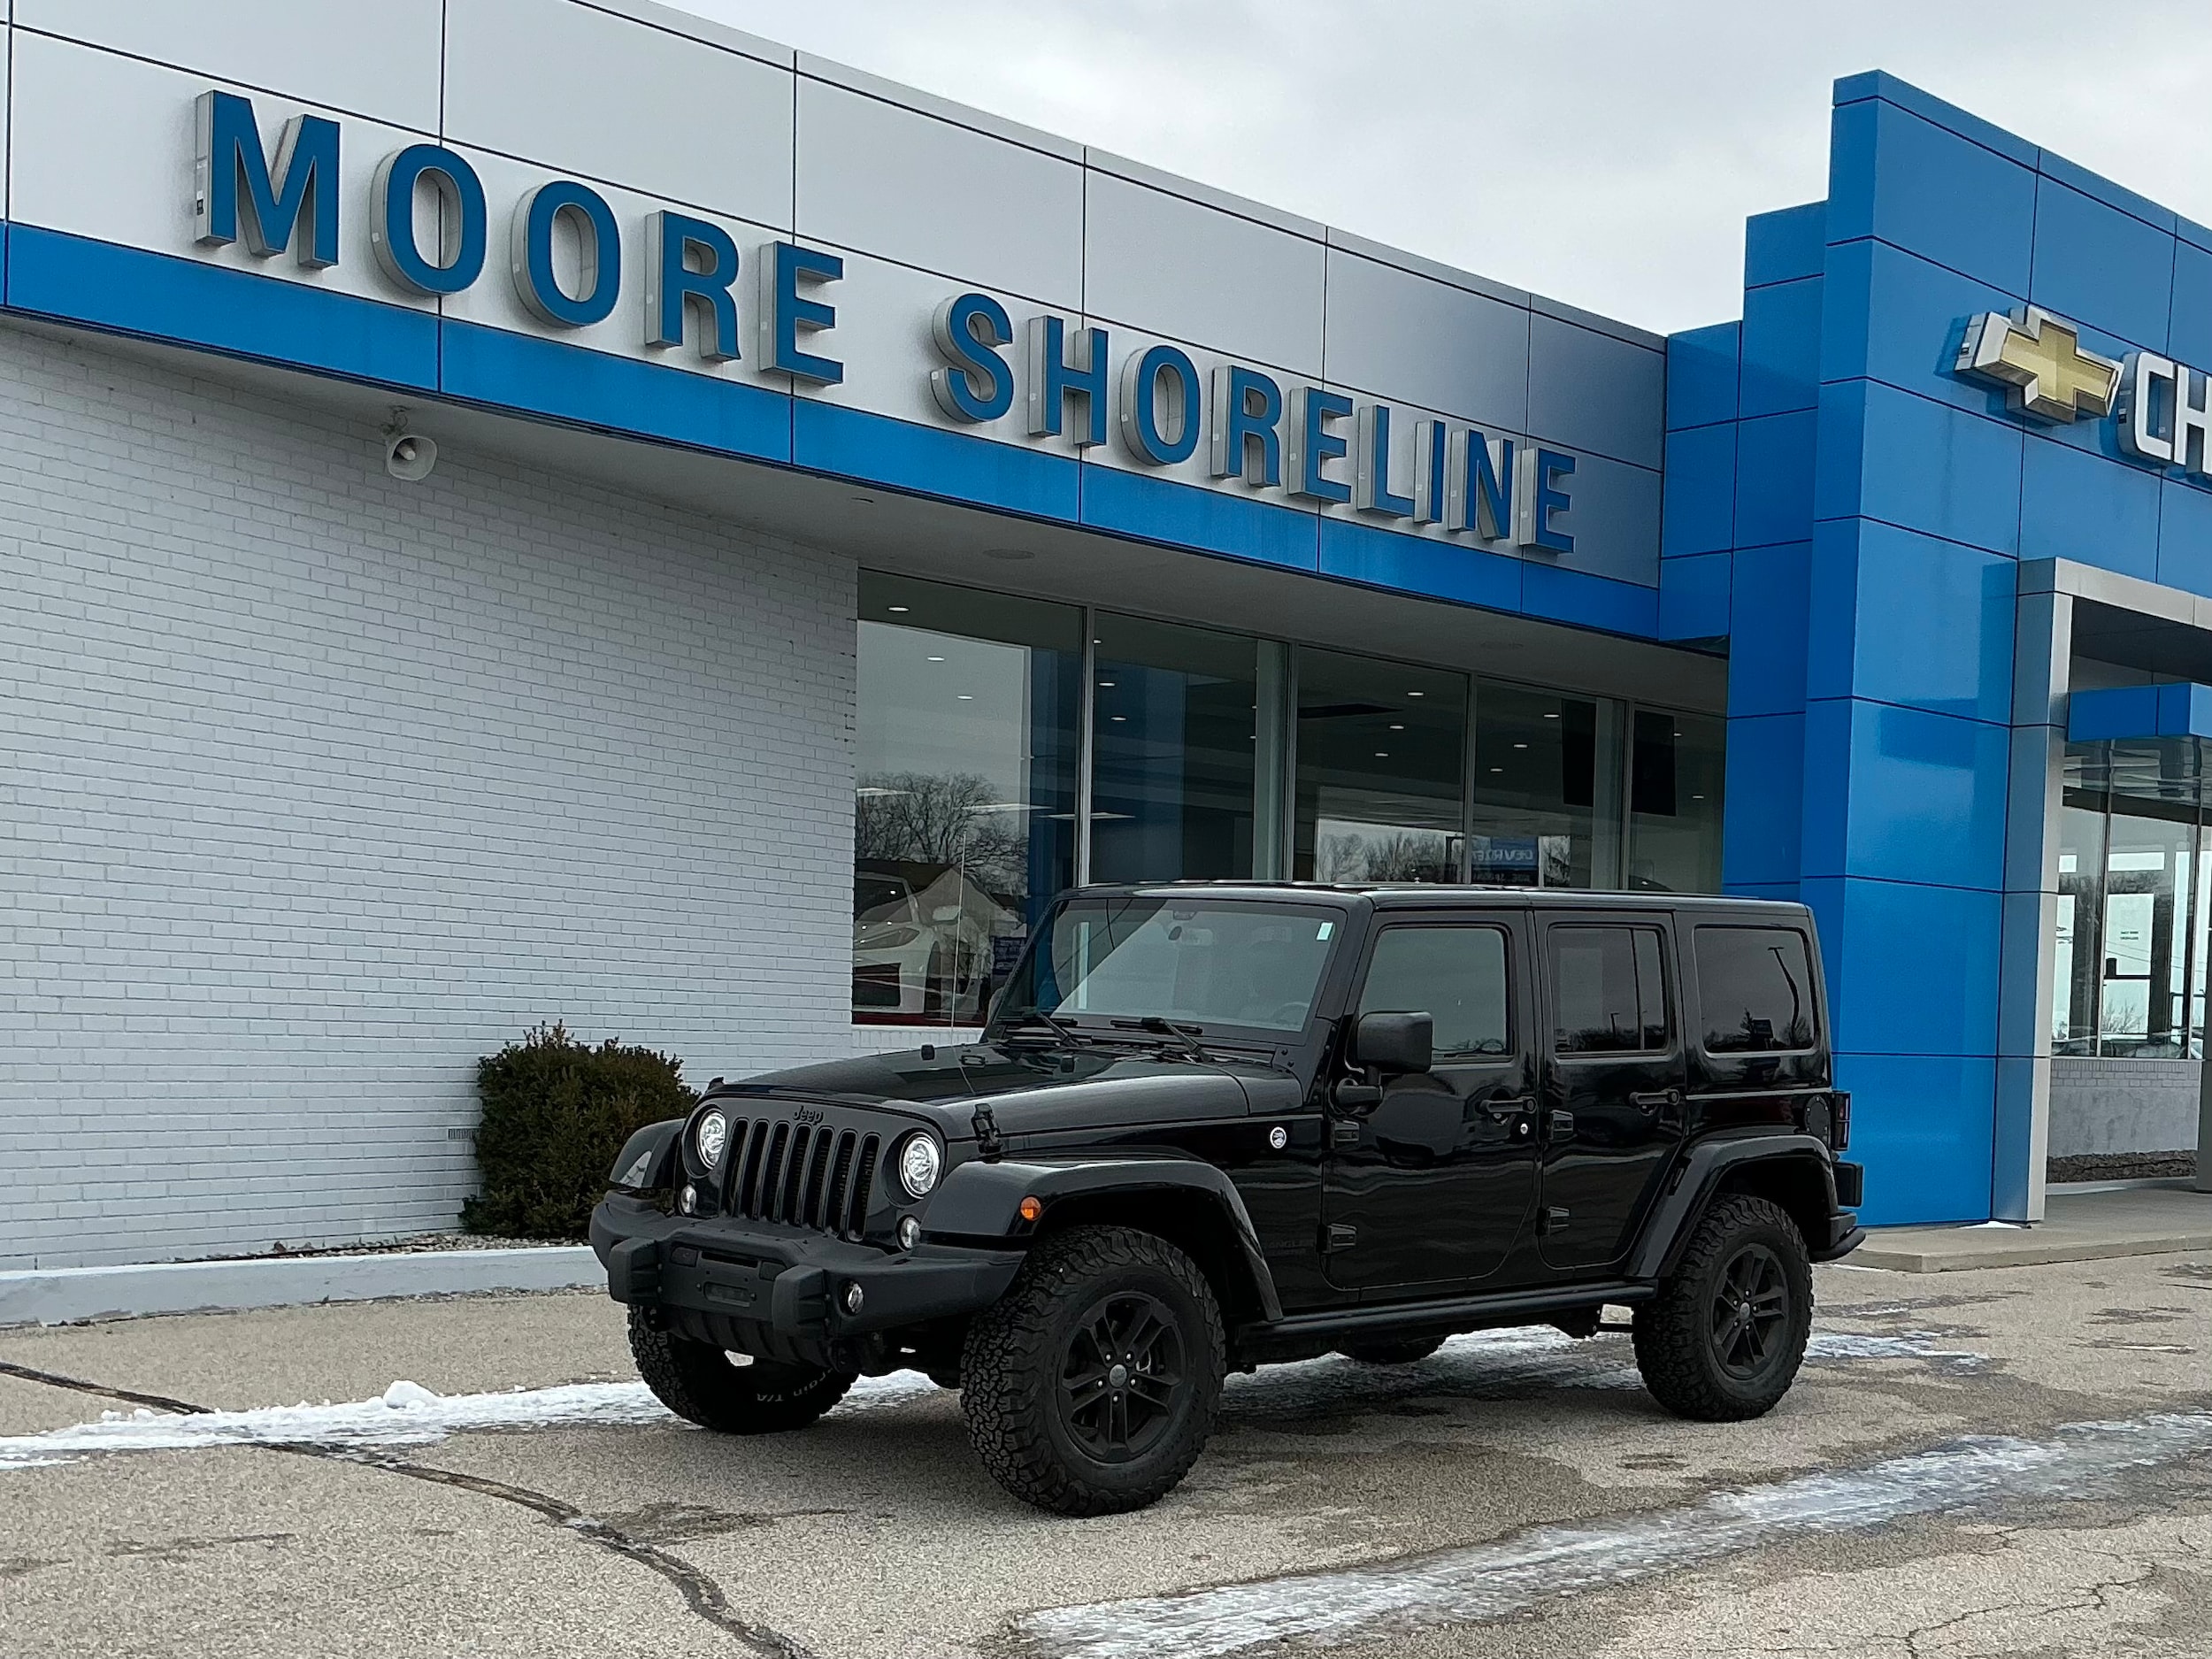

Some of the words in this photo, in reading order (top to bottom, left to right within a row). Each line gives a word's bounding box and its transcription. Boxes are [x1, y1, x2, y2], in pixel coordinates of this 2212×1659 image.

[196, 89, 844, 388] MOORE
[931, 292, 1578, 555] SHORELINE
[794, 1105, 824, 1125] Jeep
